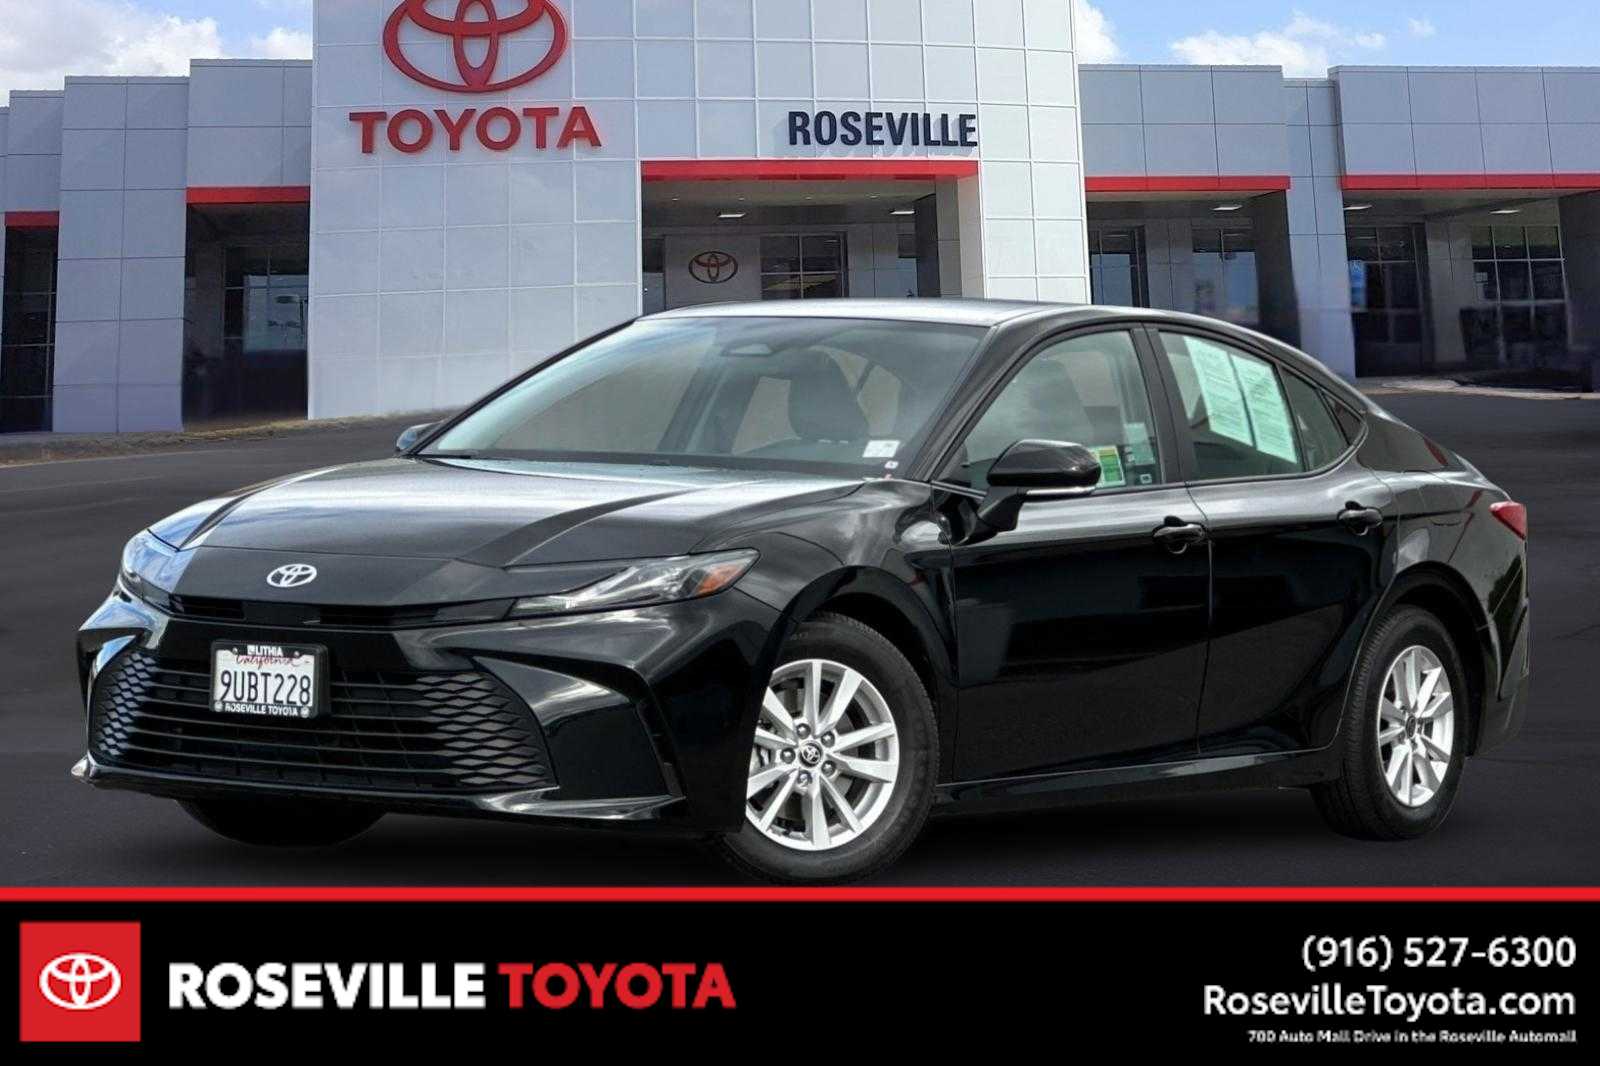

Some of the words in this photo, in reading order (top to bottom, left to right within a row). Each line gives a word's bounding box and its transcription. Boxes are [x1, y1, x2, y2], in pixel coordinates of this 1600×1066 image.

[349, 105, 602, 153] TOYOTA
[789, 111, 978, 147] ROSEVILLE
[255, 645, 283, 656] LITHIA
[220, 670, 311, 706] 9UBT228
[225, 703, 267, 714] ROSEVILLE
[268, 704, 298, 716] TOYOTA
